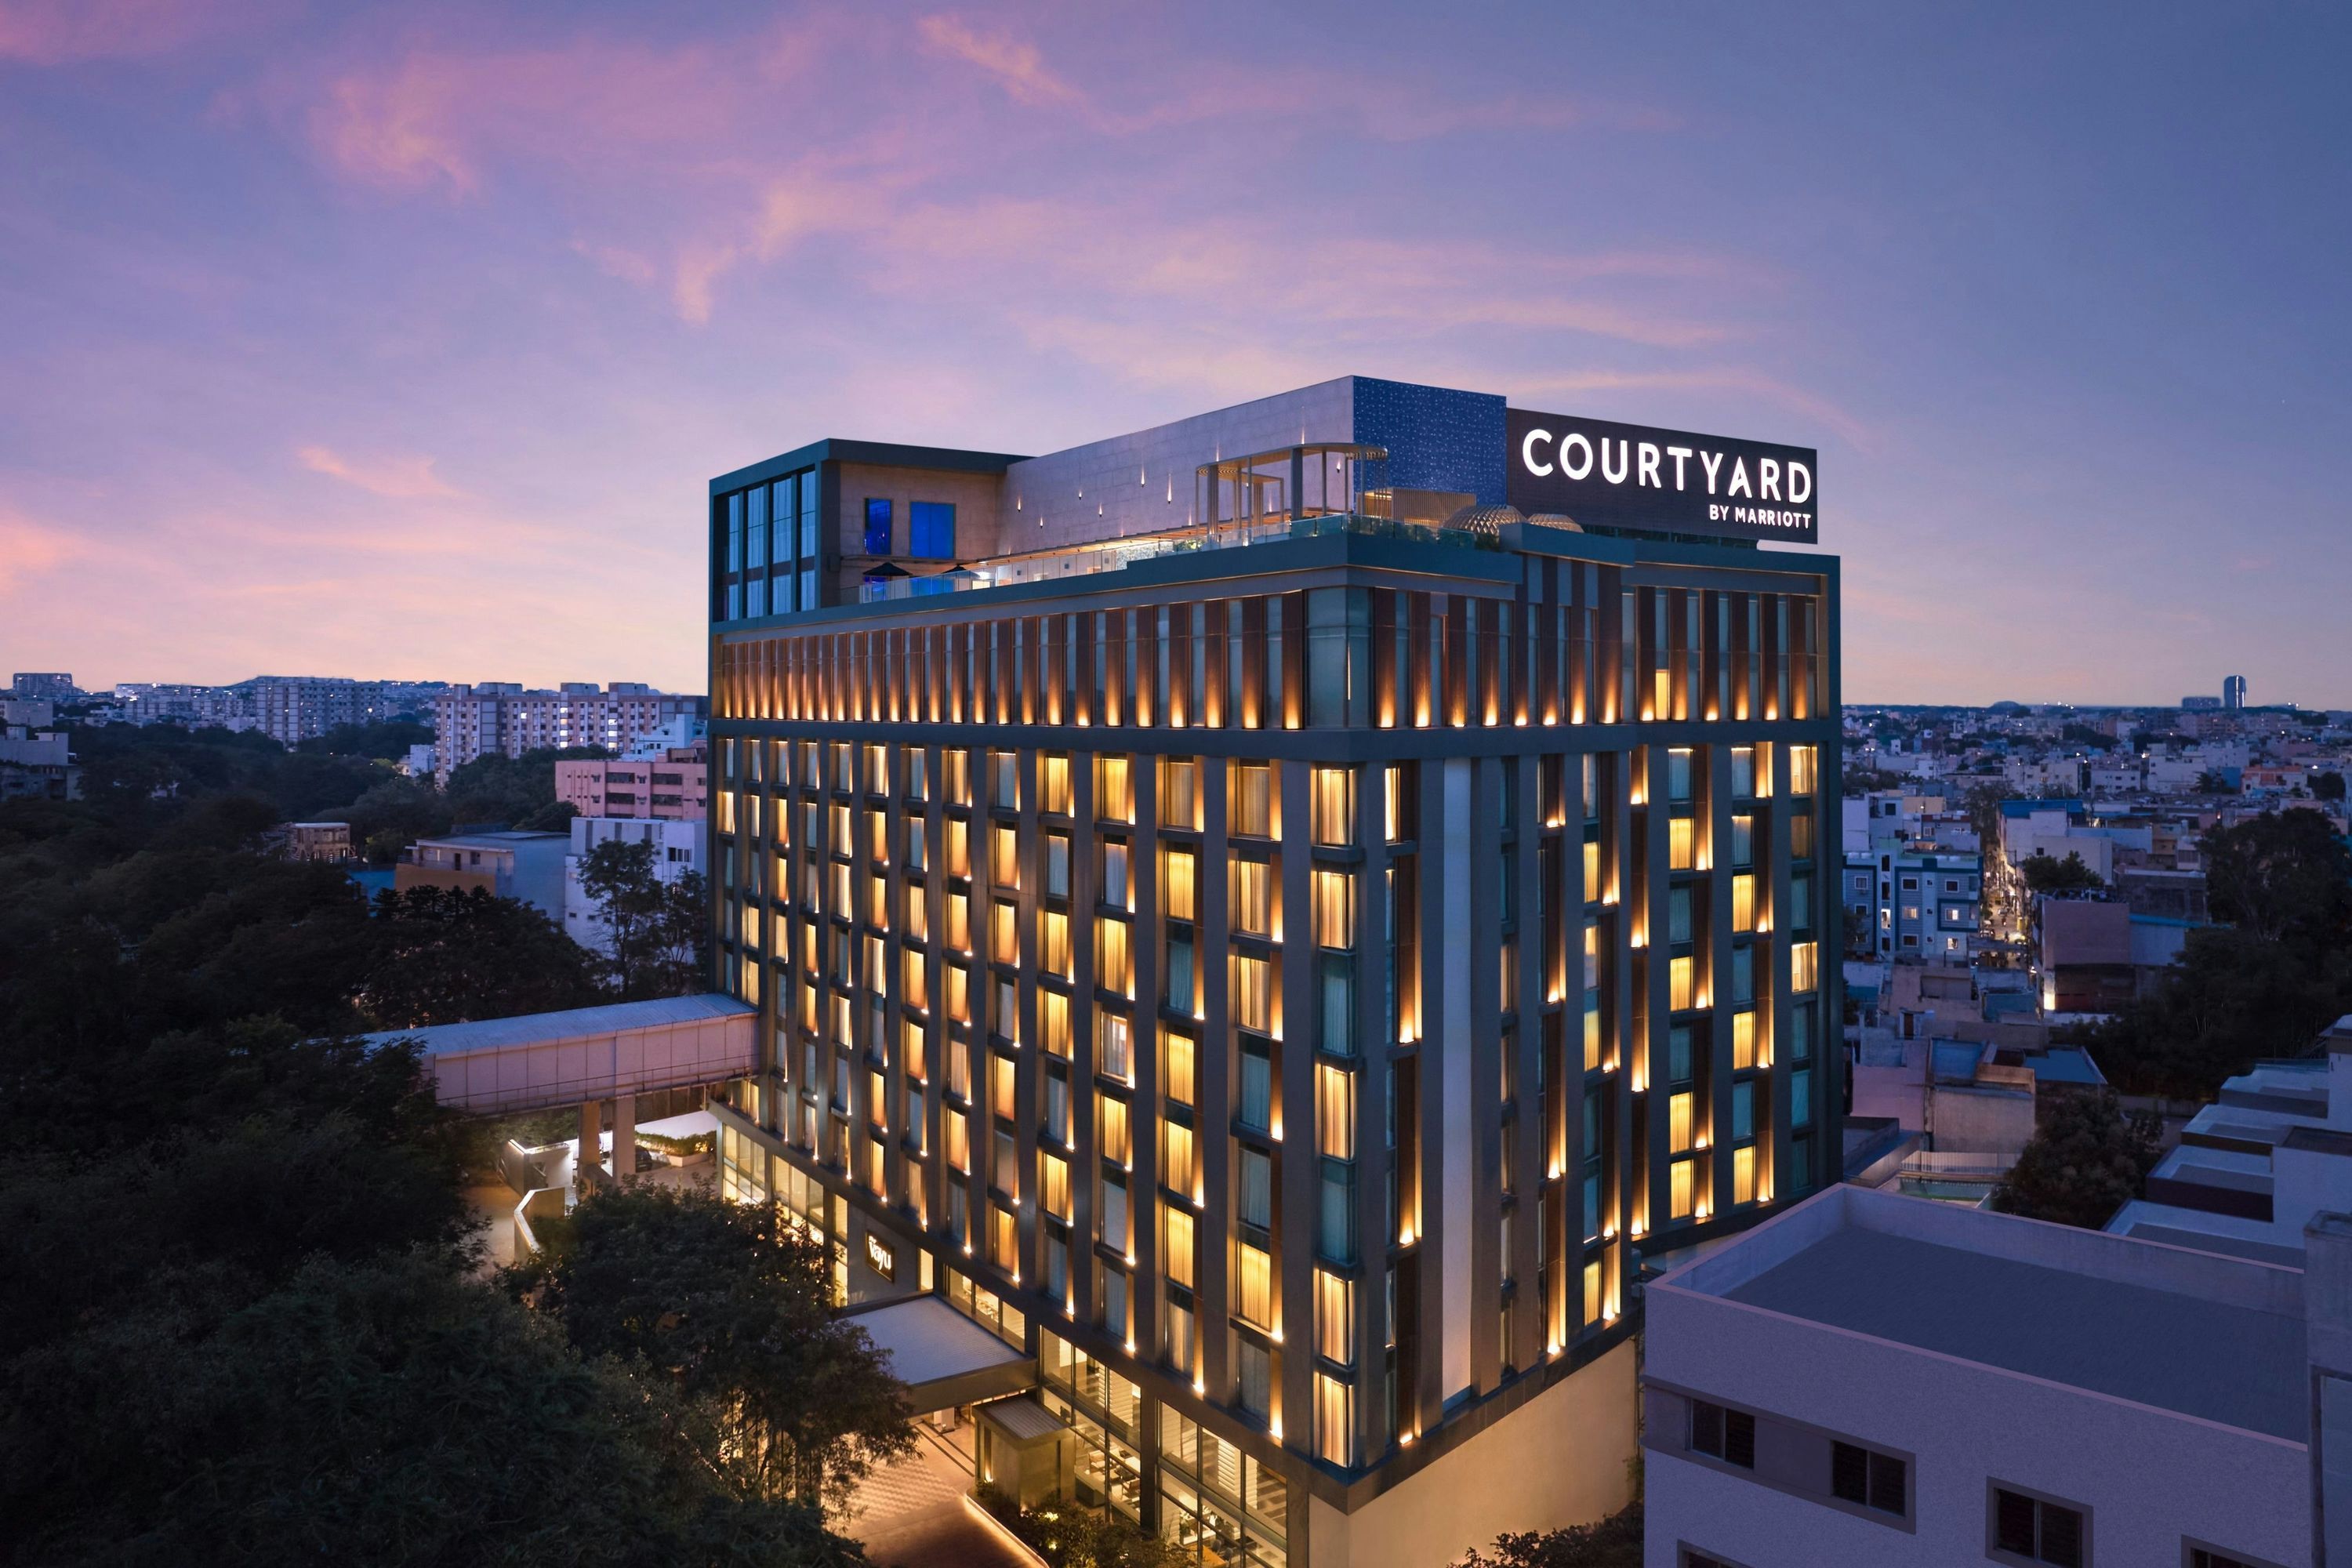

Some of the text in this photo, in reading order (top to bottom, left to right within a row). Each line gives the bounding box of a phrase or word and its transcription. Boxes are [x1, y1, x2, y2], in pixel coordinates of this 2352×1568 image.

[1522, 428, 1812, 504] COURTYARD
[1709, 504, 1812, 529] BY MARRIOTT
